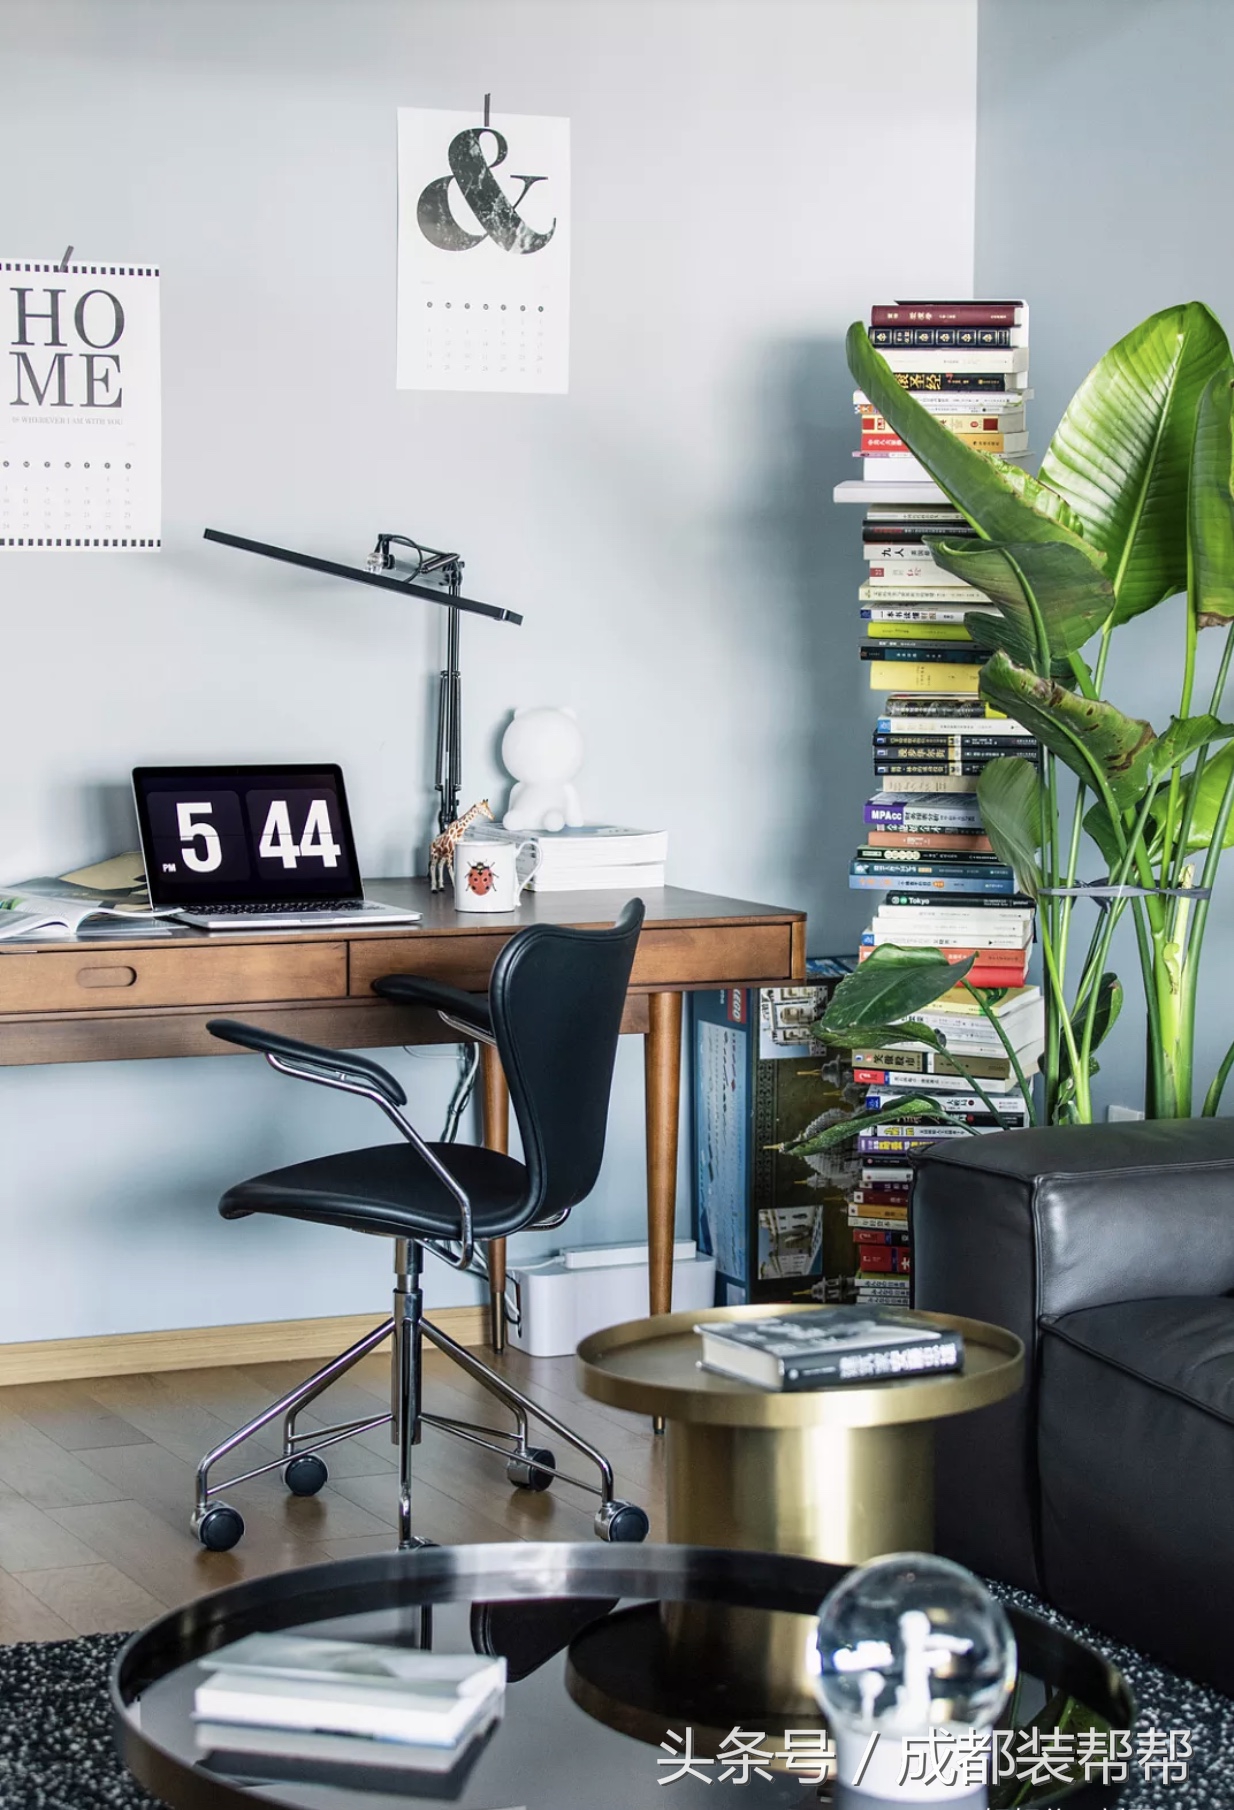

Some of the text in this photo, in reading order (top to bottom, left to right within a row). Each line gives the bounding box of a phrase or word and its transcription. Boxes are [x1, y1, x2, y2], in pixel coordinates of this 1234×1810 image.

[9, 287, 125, 349] HO
[9, 351, 122, 408] ME
[881, 547, 904, 558] 九人
[871, 809, 902, 820] MPAcc
[176, 800, 341, 873] 5 44
[162, 863, 177, 873] PM
[909, 896, 930, 905] Tokyo
[732, 988, 742, 1022] LEGO
[873, 1053, 915, 1067] 笑傲股市
